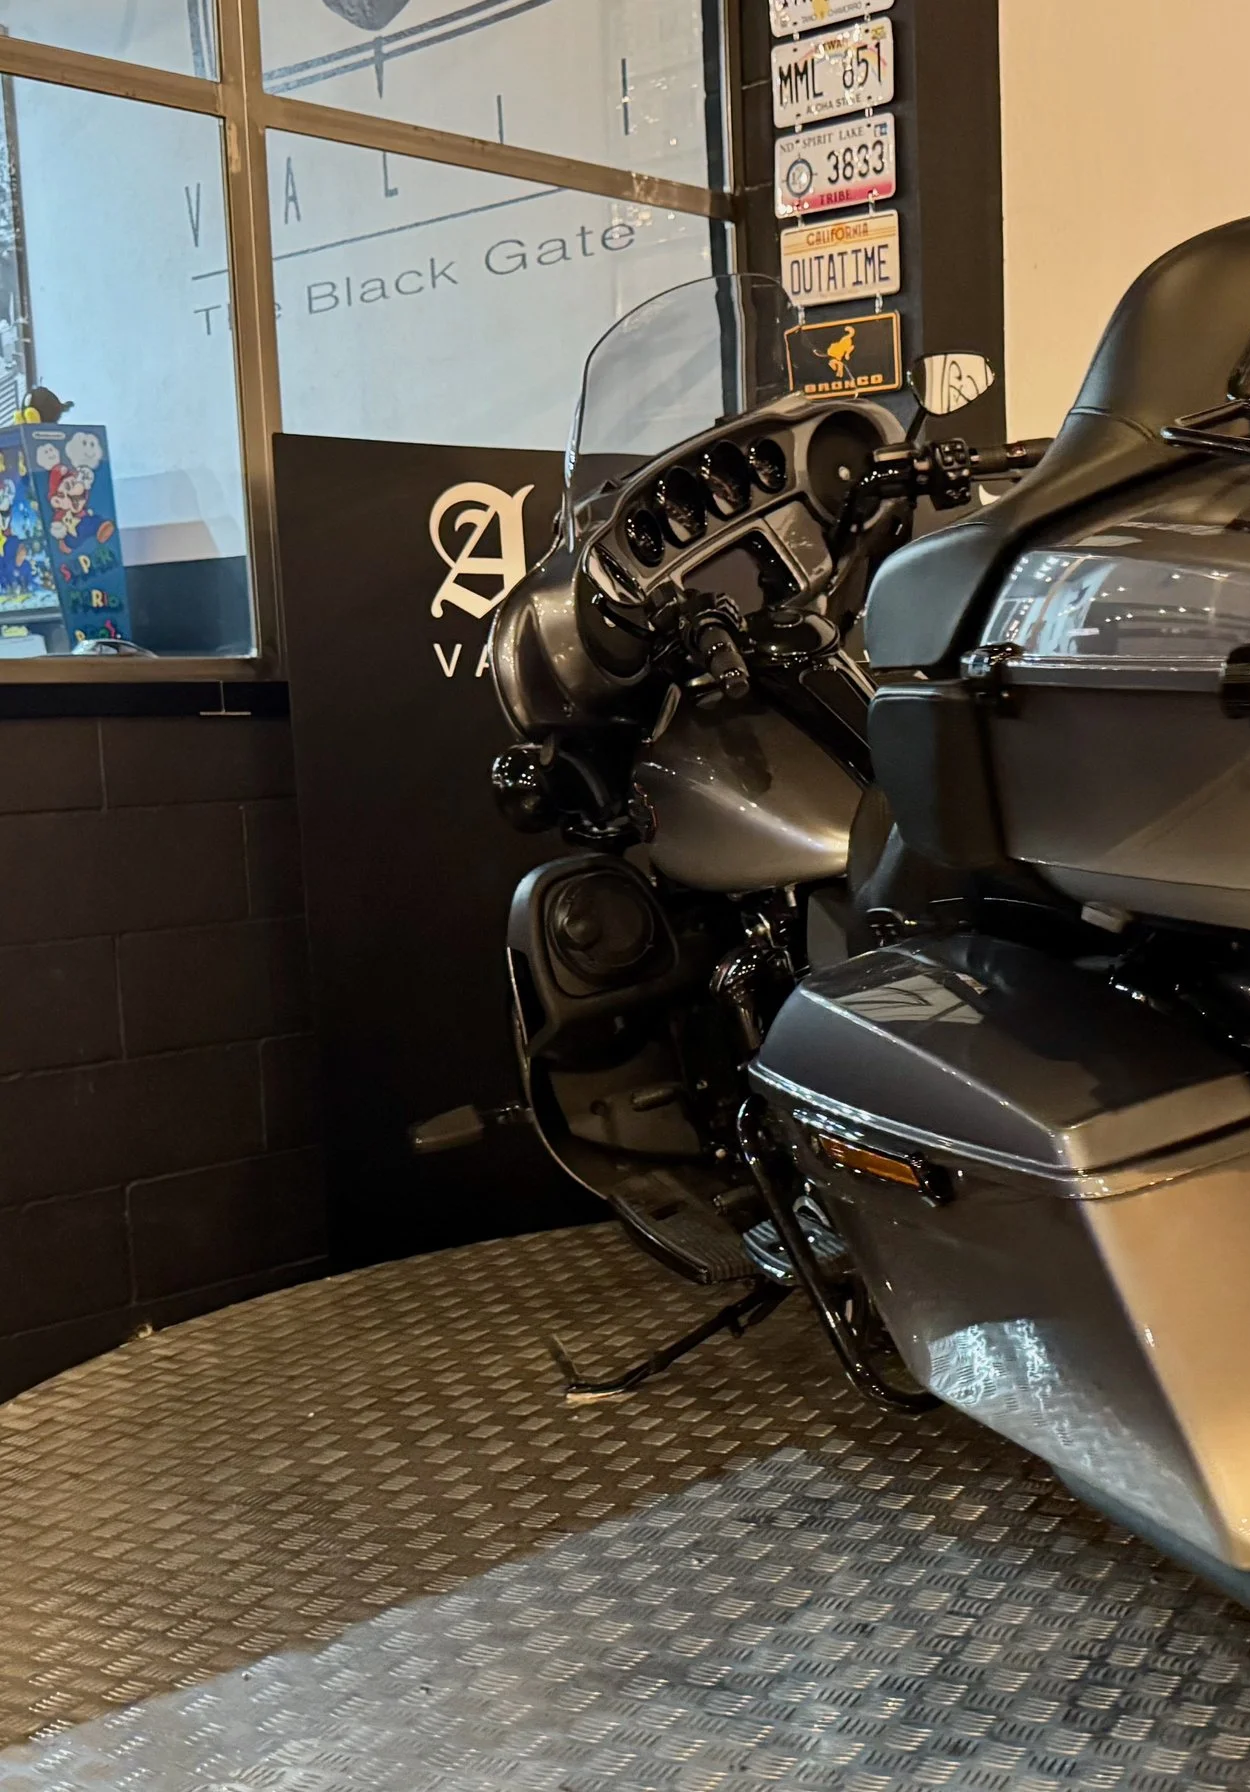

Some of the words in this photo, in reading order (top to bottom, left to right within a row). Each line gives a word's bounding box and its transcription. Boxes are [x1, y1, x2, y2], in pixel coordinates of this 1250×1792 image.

[779, 58, 823, 107] MML
[802, 133, 832, 148] SPIRIT
[839, 126, 864, 140] LAKE
[827, 140, 885, 184] 3833
[820, 190, 851, 205] TRIBE
[806, 222, 869, 246] CALIFORNIA
[307, 257, 458, 315] Black
[484, 222, 636, 275] Gate
[791, 244, 890, 295] OUTATIME
[804, 374, 883, 393] BRONCO
